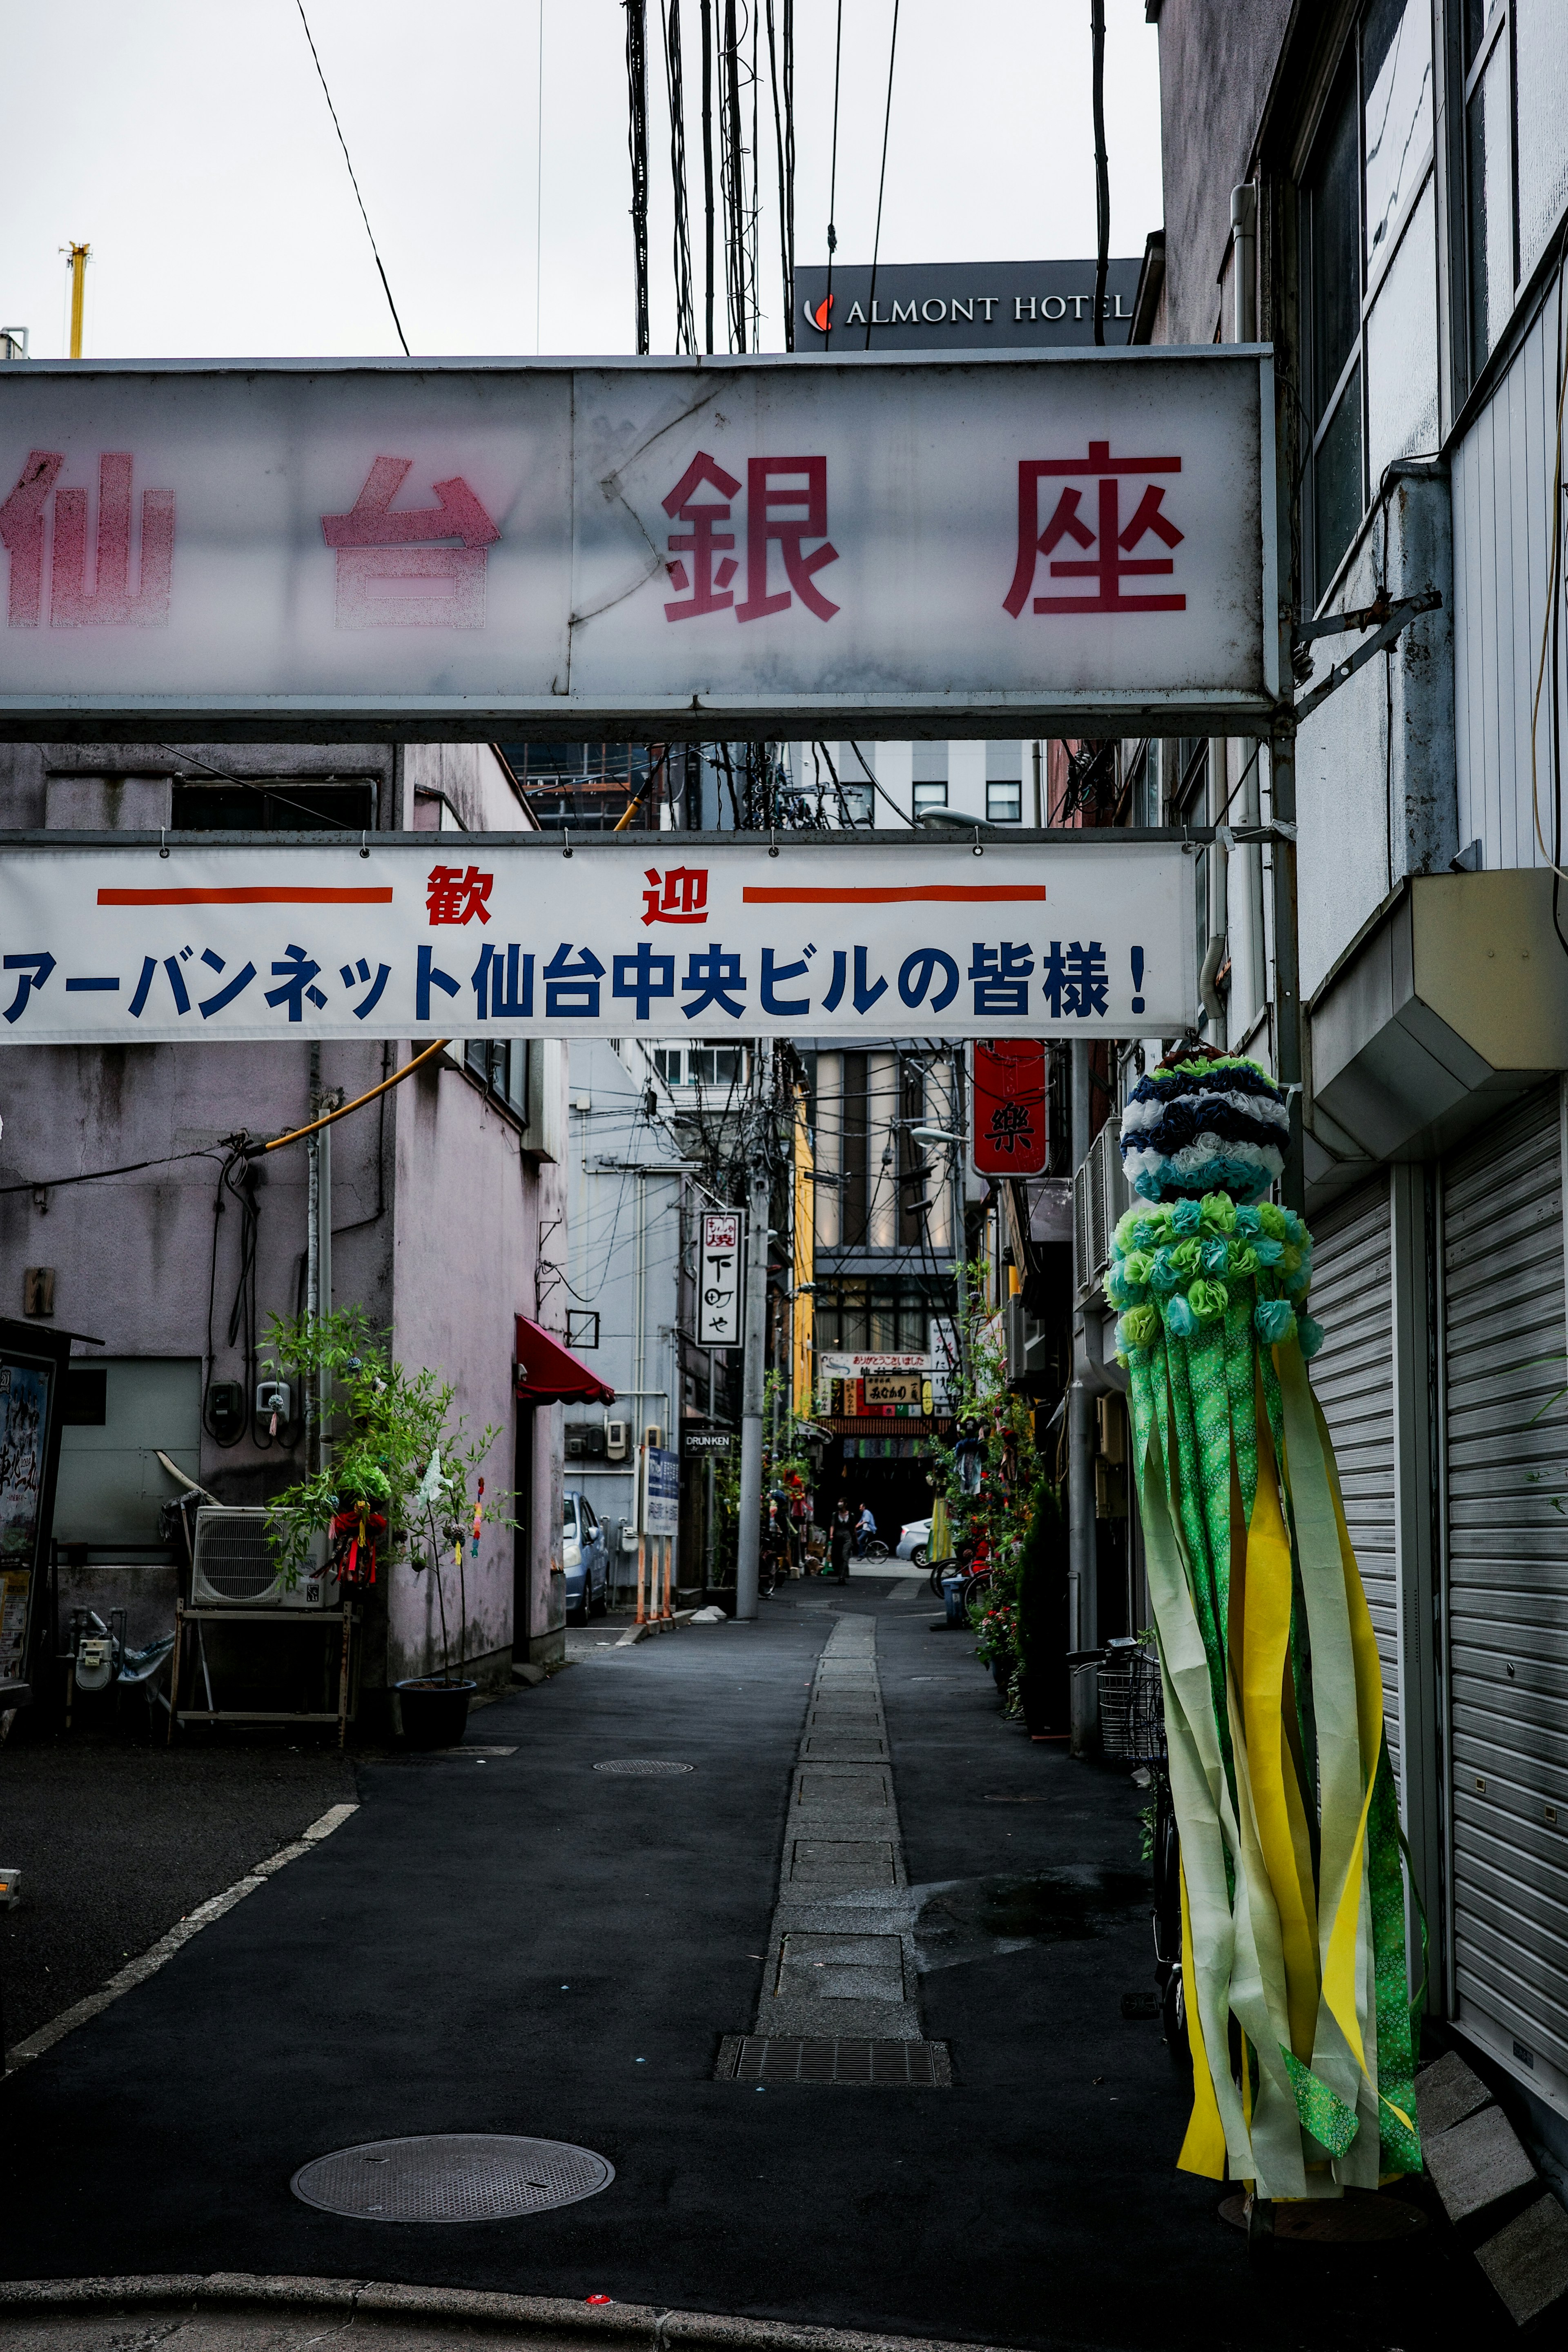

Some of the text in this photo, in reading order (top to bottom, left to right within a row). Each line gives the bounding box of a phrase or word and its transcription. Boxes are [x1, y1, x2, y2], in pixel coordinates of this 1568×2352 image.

[845, 294, 1133, 324] ALMONT HOTEL
[0, 441, 1186, 629] 仙台銀座
[425, 865, 709, 927] 歓迎
[2, 942, 1145, 1024] アーバンネット仙台中央ビルの皆様！
[983, 1101, 1036, 1154] 樂
